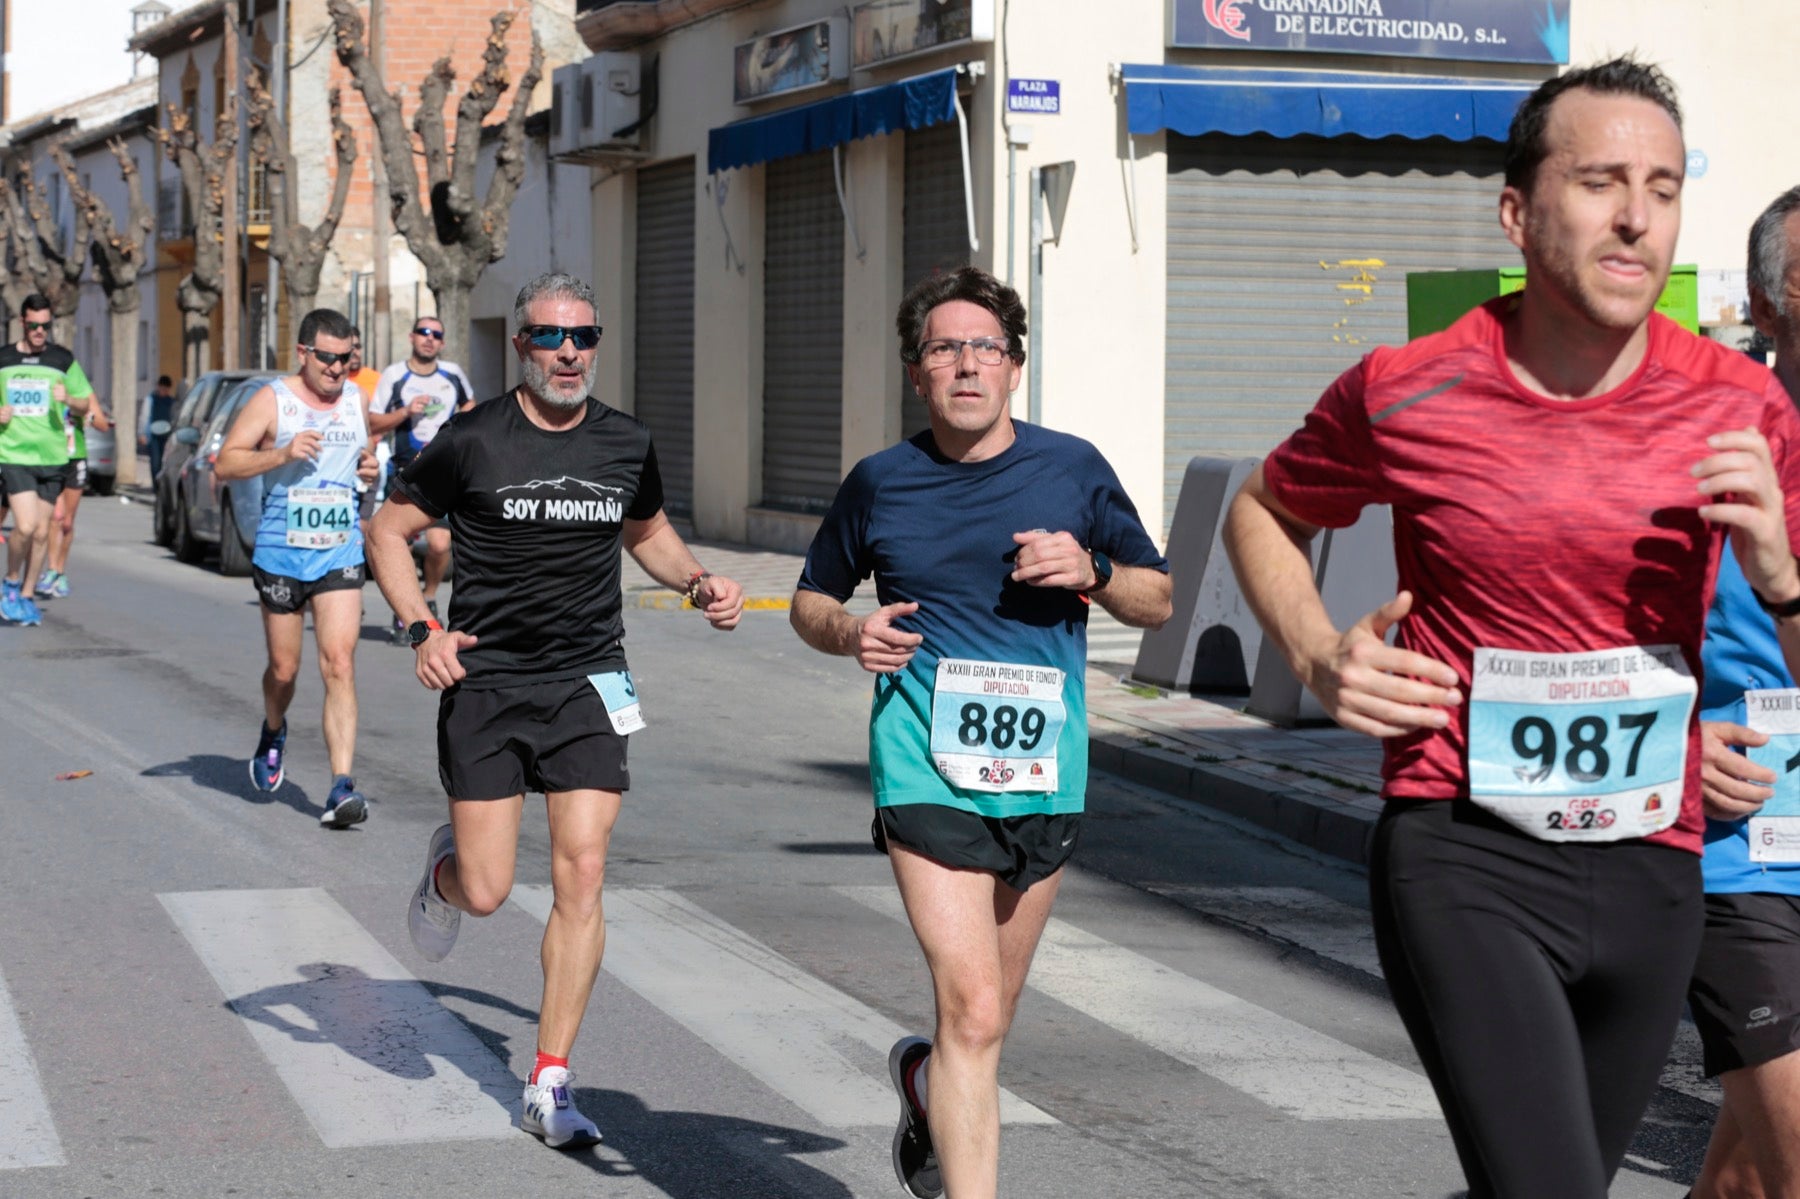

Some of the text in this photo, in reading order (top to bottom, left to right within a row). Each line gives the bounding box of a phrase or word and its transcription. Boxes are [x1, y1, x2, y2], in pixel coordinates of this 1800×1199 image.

[1259, 0, 1384, 16] GRANADINA
[1275, 14, 1507, 44] DE ELECTRICIDAD, S.L.
[1018, 80, 1048, 92] PLAZA
[1010, 95, 1058, 111] NARANJOS
[13, 391, 42, 404] 200
[292, 506, 351, 529] 1044
[502, 498, 540, 520] SOY
[947, 663, 1058, 685] XXXIII GRAN PREMIO DE FONDO
[1488, 655, 1526, 677] XXXIII
[1529, 660, 1567, 678] GRAN
[1571, 657, 1620, 677] PREMIO
[1624, 656, 1638, 673] DE
[982, 679, 1030, 695] DIPUTACIÓN
[1549, 678, 1630, 700] DIPUTACIÓN
[958, 702, 1046, 751] 889
[1511, 711, 1658, 783] 987
